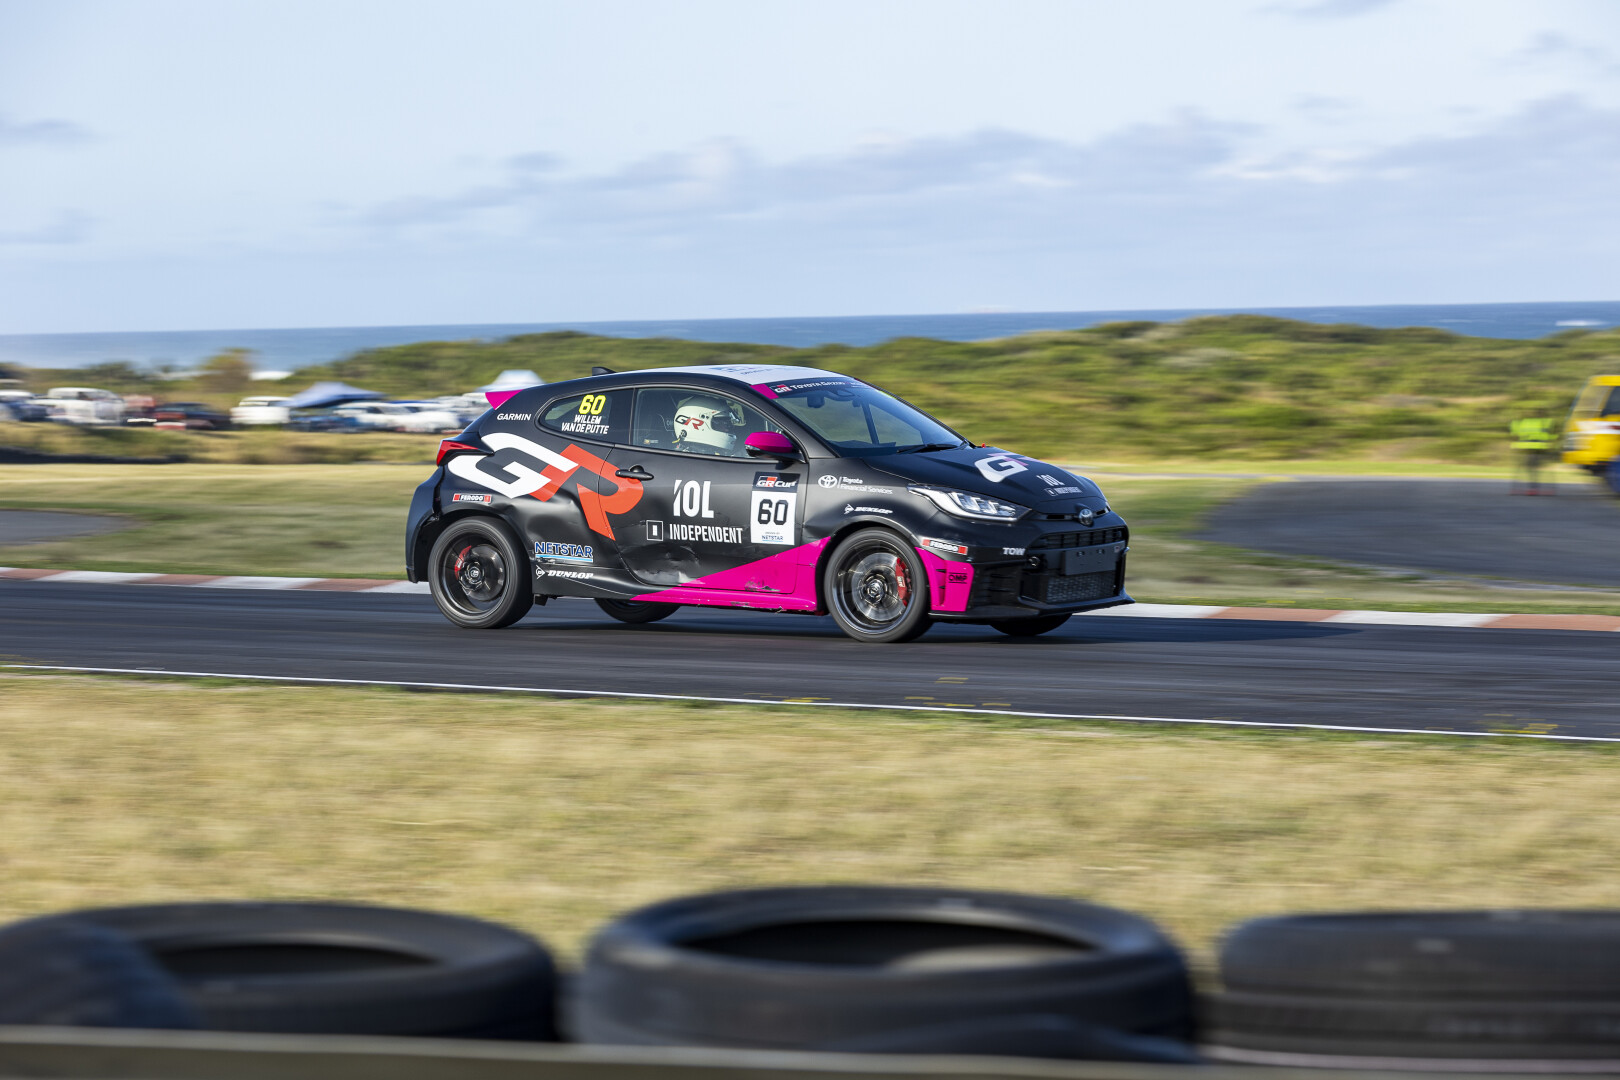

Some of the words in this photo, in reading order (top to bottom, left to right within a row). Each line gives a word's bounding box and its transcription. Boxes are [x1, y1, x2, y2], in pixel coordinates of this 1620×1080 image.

[578, 394, 606, 415] 60
[496, 413, 532, 421] GARMIN
[574, 414, 602, 424] WILLEM
[675, 414, 704, 430] GR
[561, 422, 576, 432] VAN
[576, 424, 585, 432] DE
[585, 424, 610, 435] PUTTE
[756, 479, 775, 488] GR
[842, 476, 863, 485] Toyota
[448, 432, 644, 541] GR
[840, 484, 867, 492] Financial
[868, 486, 893, 495] Services
[757, 498, 790, 526] 60
[669, 523, 743, 544] INDEPENDENT
[534, 541, 593, 558] NETSTAR
[1002, 547, 1026, 556] TOW
[547, 569, 594, 579] DUNLOP
[948, 574, 967, 582] OMP
